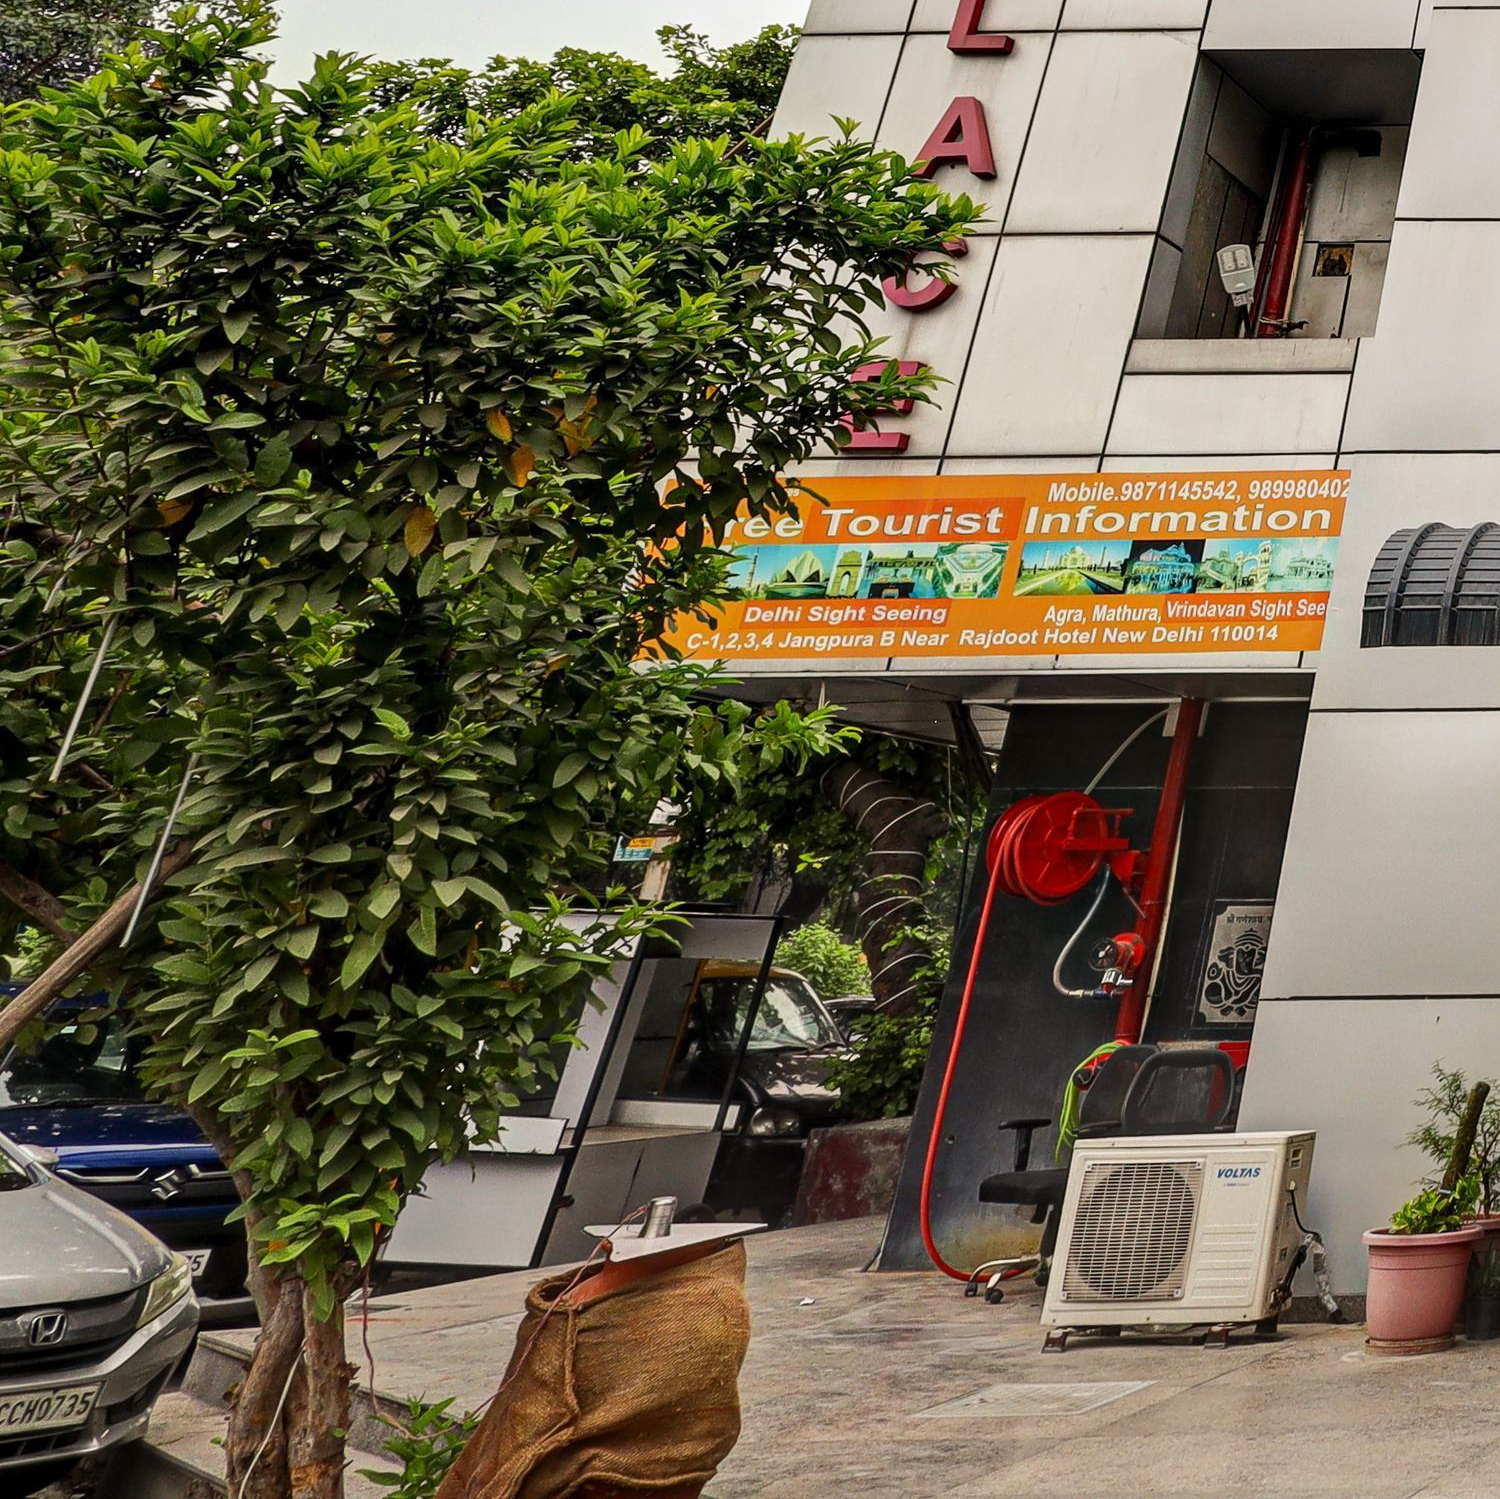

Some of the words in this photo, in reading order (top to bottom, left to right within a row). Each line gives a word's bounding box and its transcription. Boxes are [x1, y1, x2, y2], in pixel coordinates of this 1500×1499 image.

[721, 513, 804, 538] ree
[820, 505, 1004, 537] Tourist
[1023, 503, 1332, 535] Information
[743, 605, 802, 623] Delhi
[806, 604, 866, 624] Sight
[871, 604, 948, 624] Seeing
[1043, 604, 1087, 626] Agra,
[1091, 604, 1162, 623] Mathura,
[1166, 599, 1246, 618] Vrindavan
[1250, 598, 1295, 621] Sight
[686, 631, 773, 651] C-1,2,3,4
[778, 630, 874, 651] Jangpura
[879, 630, 895, 646] B
[901, 630, 950, 646] Near
[959, 628, 1039, 648] Rajdoot
[1043, 627, 1096, 645] Hotel
[1102, 627, 1148, 644] New
[1151, 626, 1204, 643] Delhi
[1209, 624, 1279, 642] 110014
[1217, 1167, 1261, 1179] VOLTAS
